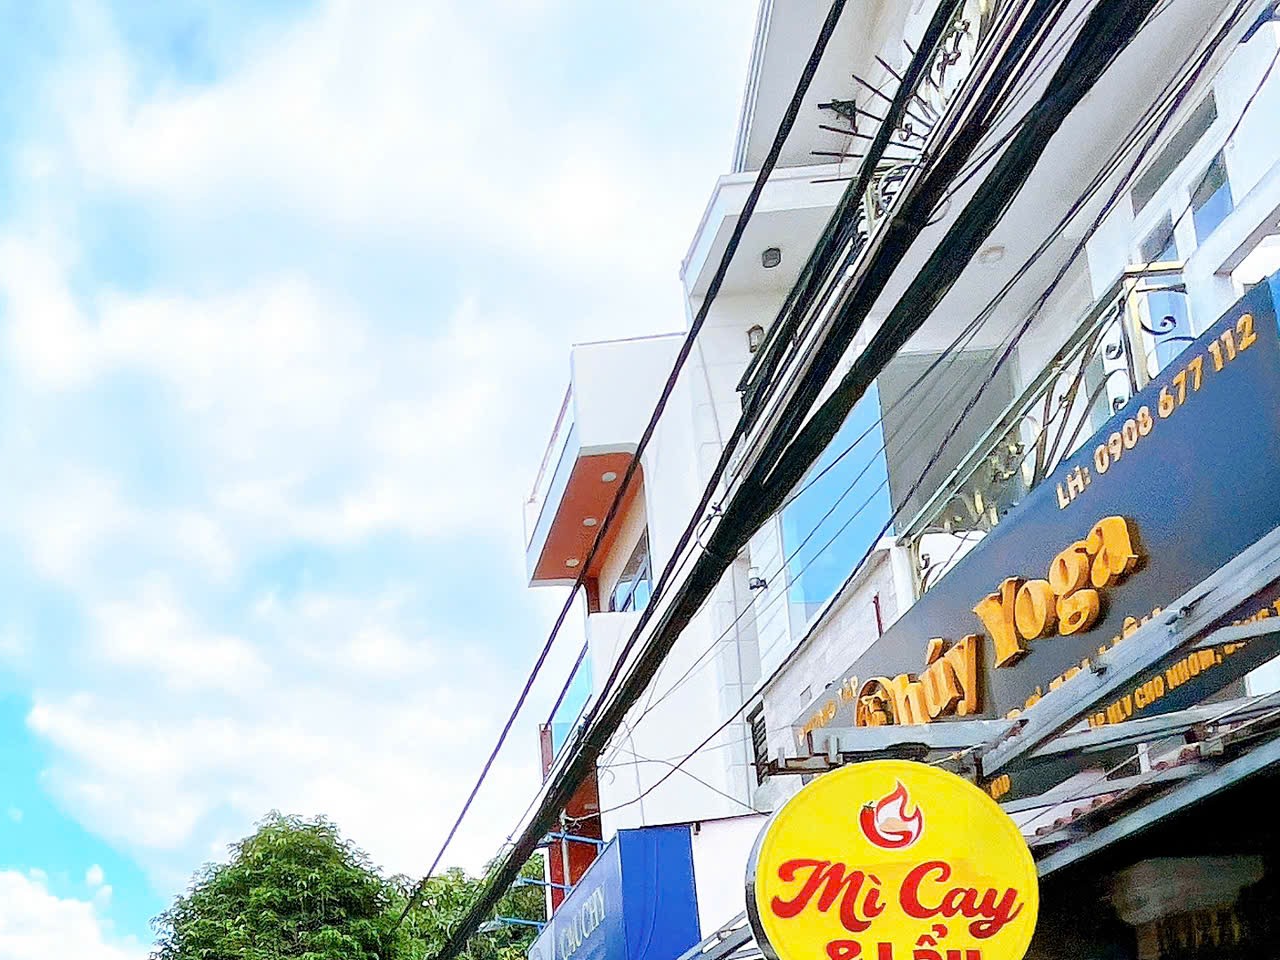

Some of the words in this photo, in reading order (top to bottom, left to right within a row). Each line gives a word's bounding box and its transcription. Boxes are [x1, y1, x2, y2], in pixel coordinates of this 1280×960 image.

[1094, 406, 1153, 474] 0908
[1158, 354, 1204, 419] 677
[1208, 313, 1258, 372] 112
[973, 515, 1139, 668] Yoga
[771, 859, 886, 932] Mì
[899, 861, 1024, 938] Cay
